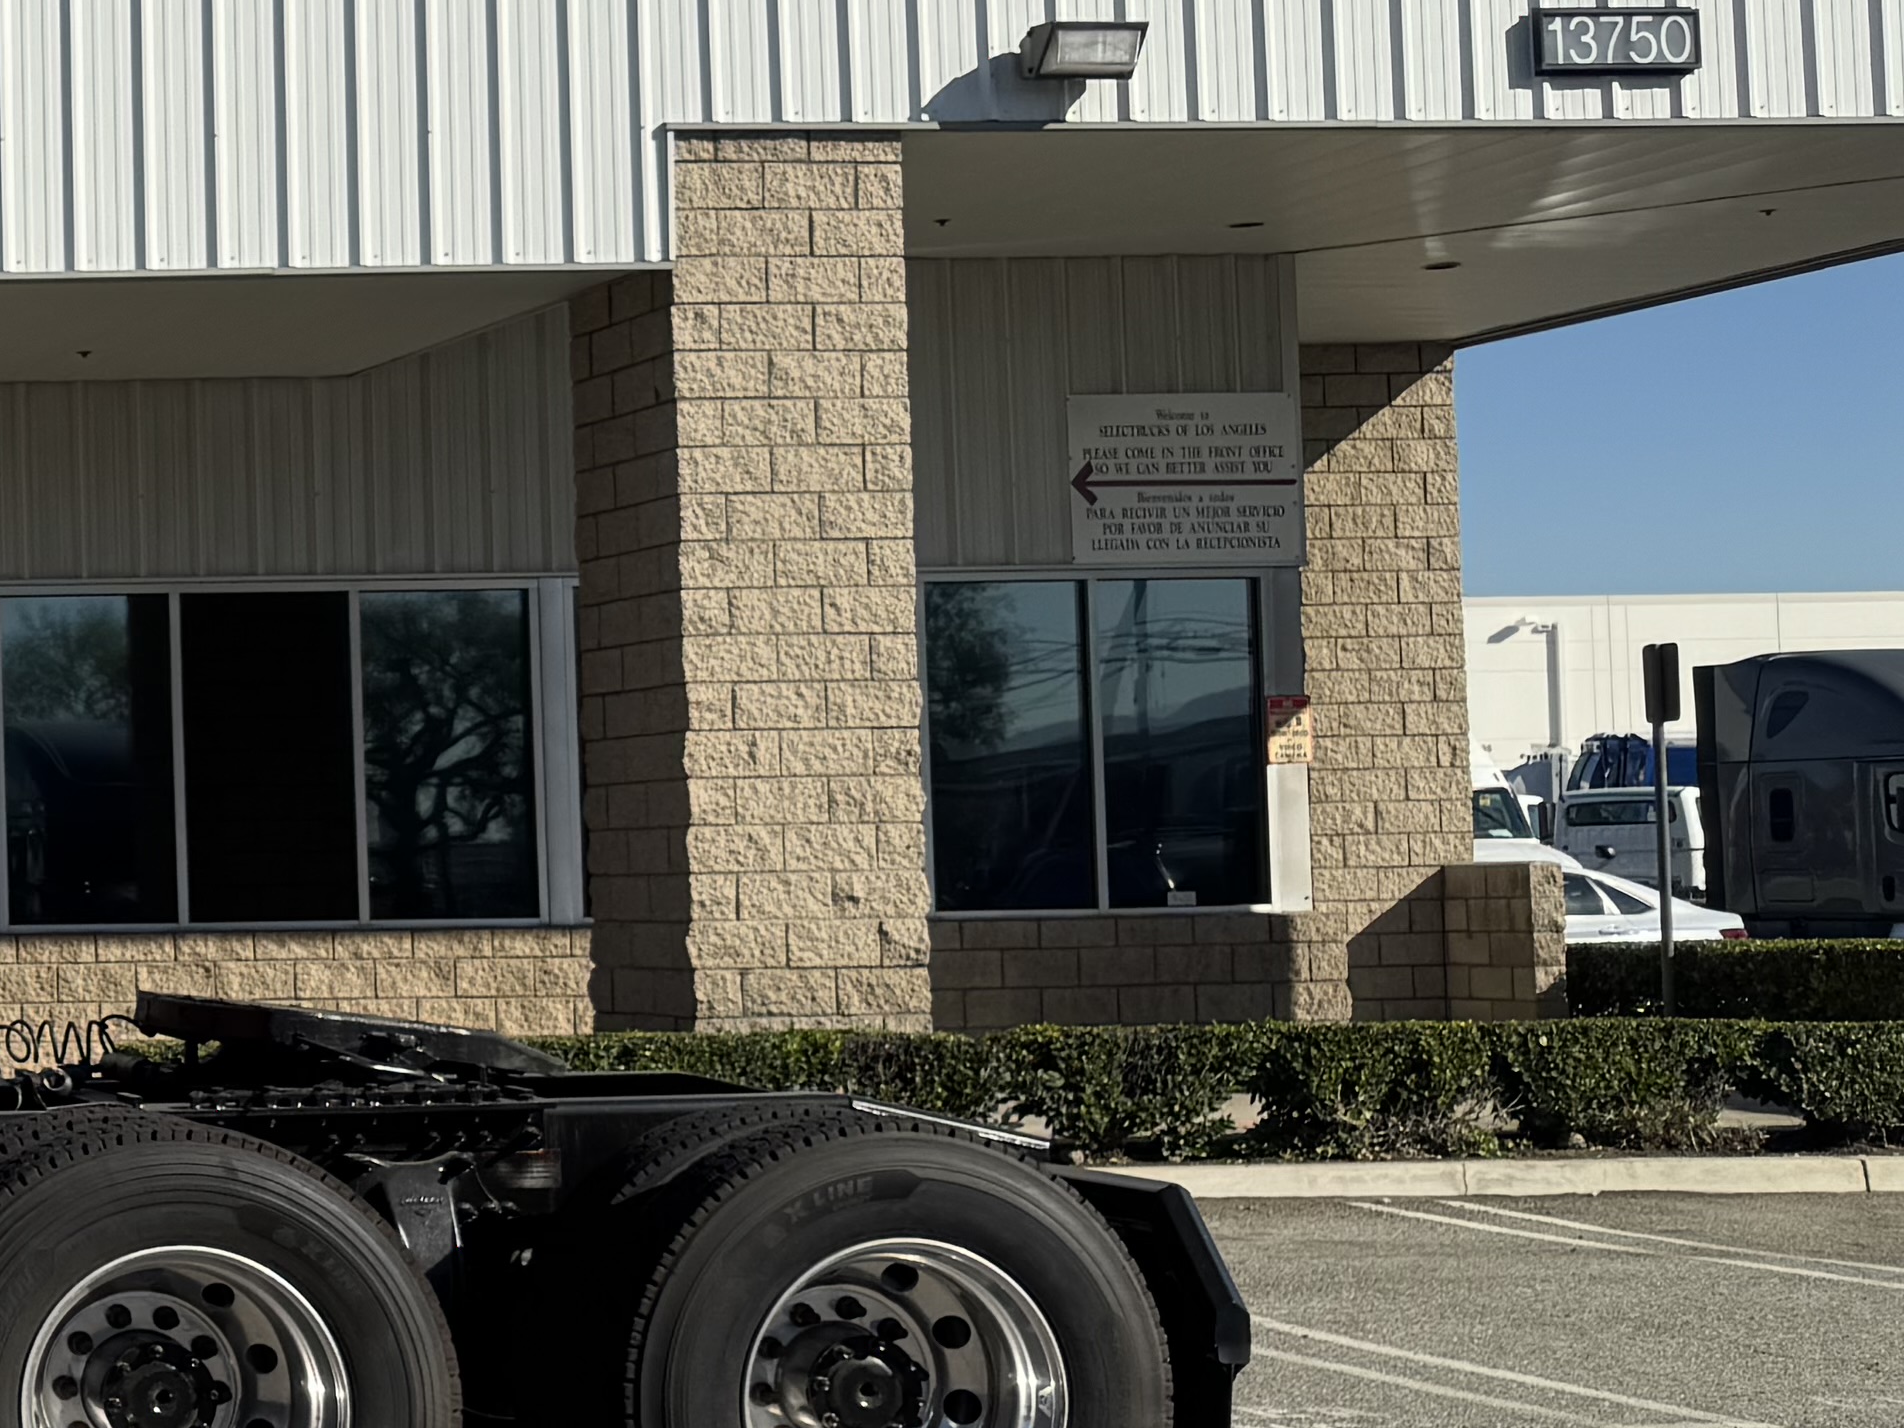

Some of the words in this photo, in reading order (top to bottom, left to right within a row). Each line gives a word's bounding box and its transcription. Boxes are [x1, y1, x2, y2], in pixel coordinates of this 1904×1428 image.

[1548, 15, 1692, 64] 13750
[1099, 424, 1170, 437] SELECTRUCKS
[1176, 425, 1188, 436] OF
[1195, 424, 1214, 436] LOS
[1221, 423, 1267, 436] ANGELES
[1083, 447, 1119, 460] PLEASE
[1125, 447, 1155, 459] COME
[1162, 447, 1174, 458] IN
[1182, 447, 1201, 458] THE
[1208, 446, 1242, 458] FRONT
[1249, 445, 1284, 457] OFFICE
[1093, 463, 1109, 476] SO
[1115, 463, 1130, 475] WE
[1137, 462, 1160, 474] CAN
[1166, 462, 1206, 474] BETTER
[1213, 461, 1245, 473] ASSIST
[1252, 461, 1273, 473] YOU
[1086, 508, 1115, 520] PARA
[1174, 507, 1190, 518] UN
[1196, 506, 1231, 519] MEJOR
[1237, 505, 1285, 517] SERVICIO
[1103, 523, 1124, 536] POR
[1131, 523, 1163, 535] FAVOR
[1170, 523, 1183, 534] DE
[1191, 522, 1250, 534] ANUNCIAR
[1256, 522, 1269, 533] SU
[1146, 538, 1169, 550] CON
[1176, 538, 1190, 549] LA
[1196, 536, 1280, 549] RECEPCIONISTA
[813, 1176, 874, 1207] LINE
